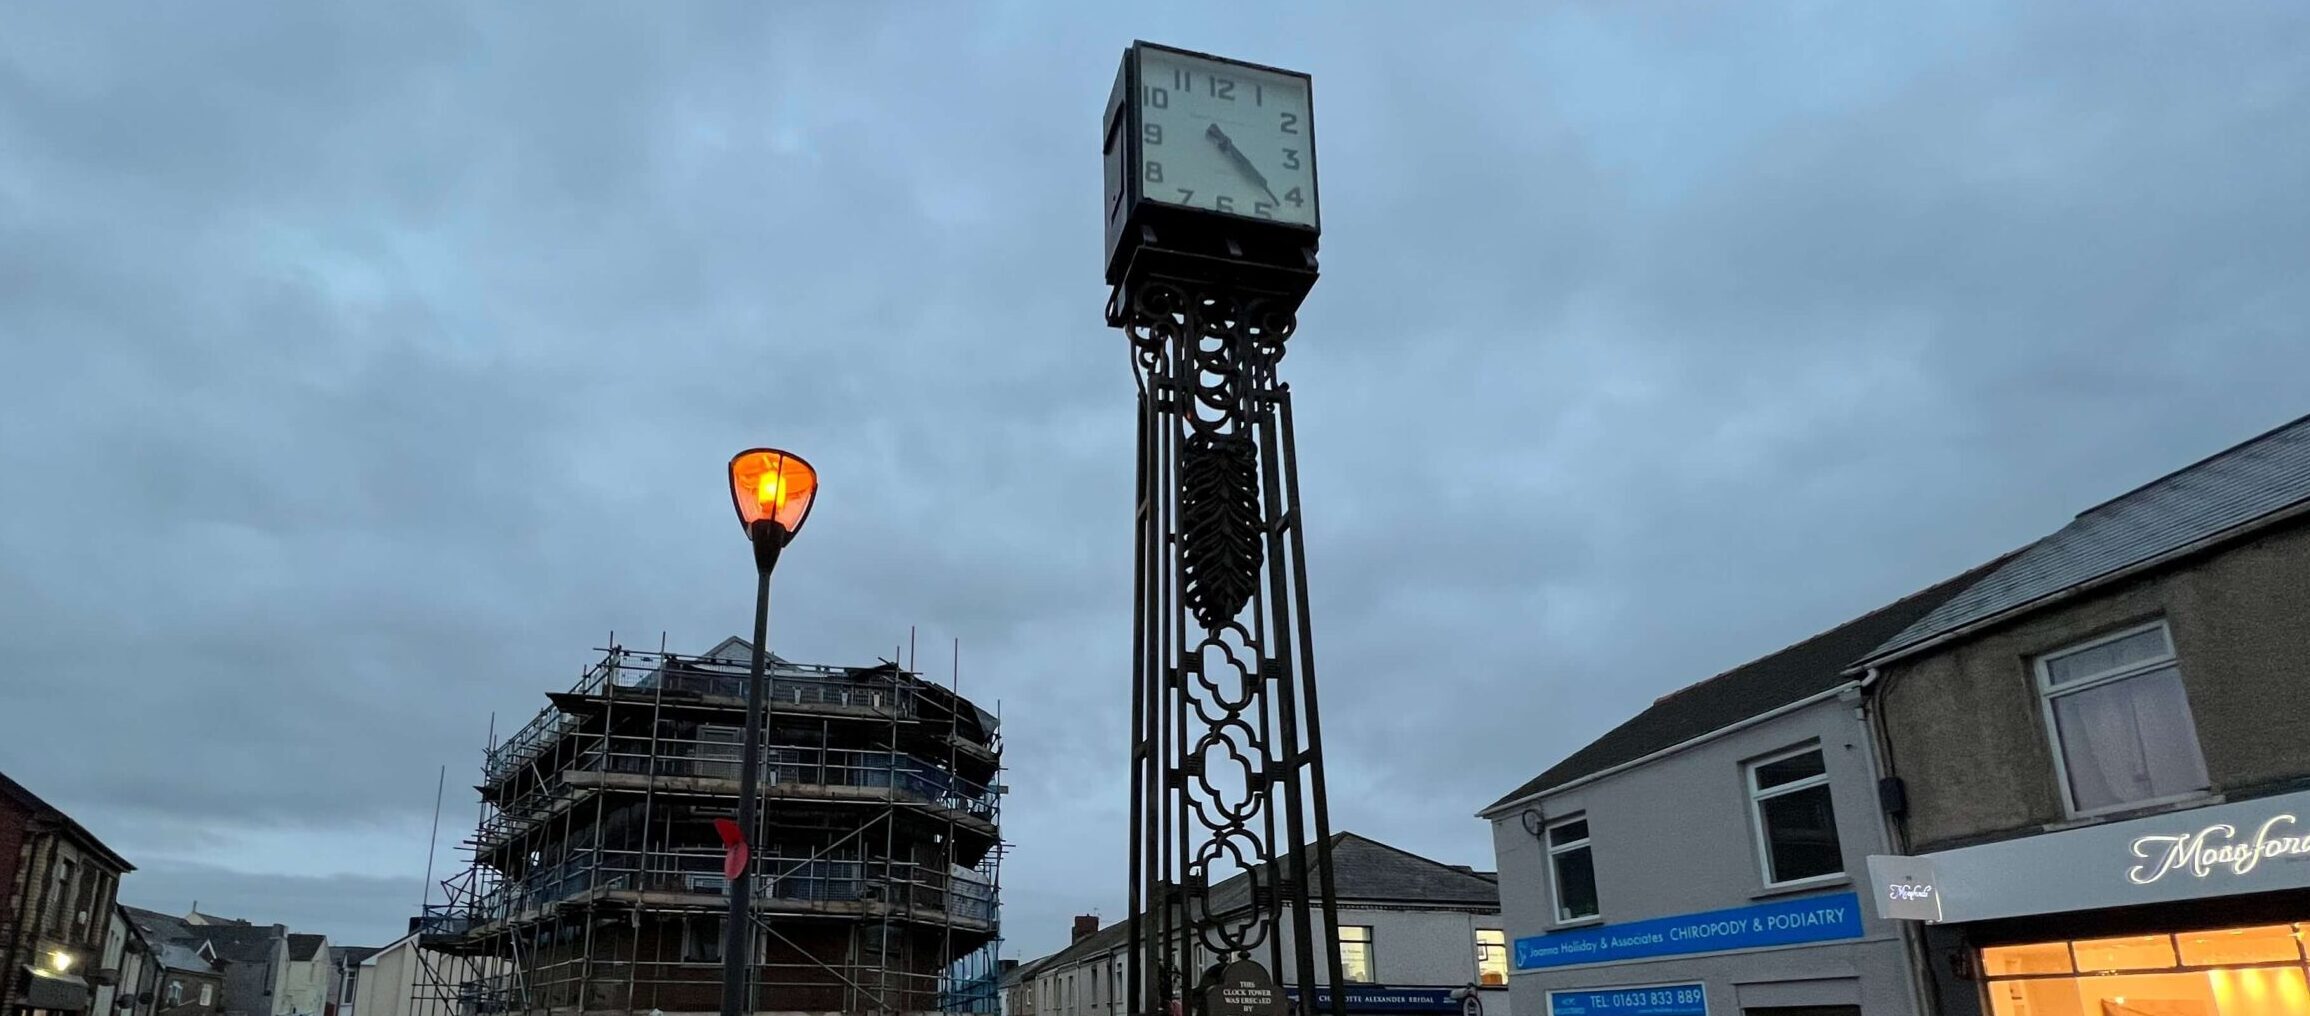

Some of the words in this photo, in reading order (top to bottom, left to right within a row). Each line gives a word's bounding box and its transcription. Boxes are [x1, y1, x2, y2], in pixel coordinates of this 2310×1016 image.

[1174, 69, 1191, 92] 11
[1209, 75, 1236, 101] 12
[1143, 85, 1169, 110] 10
[1256, 86, 1262, 106] 1
[1280, 112, 1298, 134] 2
[1143, 123, 1163, 146] 9
[1282, 148, 1300, 171] 3
[1145, 160, 1164, 183] 8
[1177, 188, 1195, 205] 7
[1284, 187, 1304, 208] 4
[1254, 202, 1273, 219] 5
[1600, 936, 1608, 950] &
[1611, 933, 1664, 949] Associates
[1669, 920, 1747, 941] CHIROPODY
[1752, 917, 1763, 933] &
[1768, 907, 1845, 931] PODIATRY
[1409, 996, 1434, 1004] BRIDAL
[1613, 993, 1646, 1007] 01633
[1650, 991, 1673, 1005] 833
[1677, 989, 1701, 1004] 889
